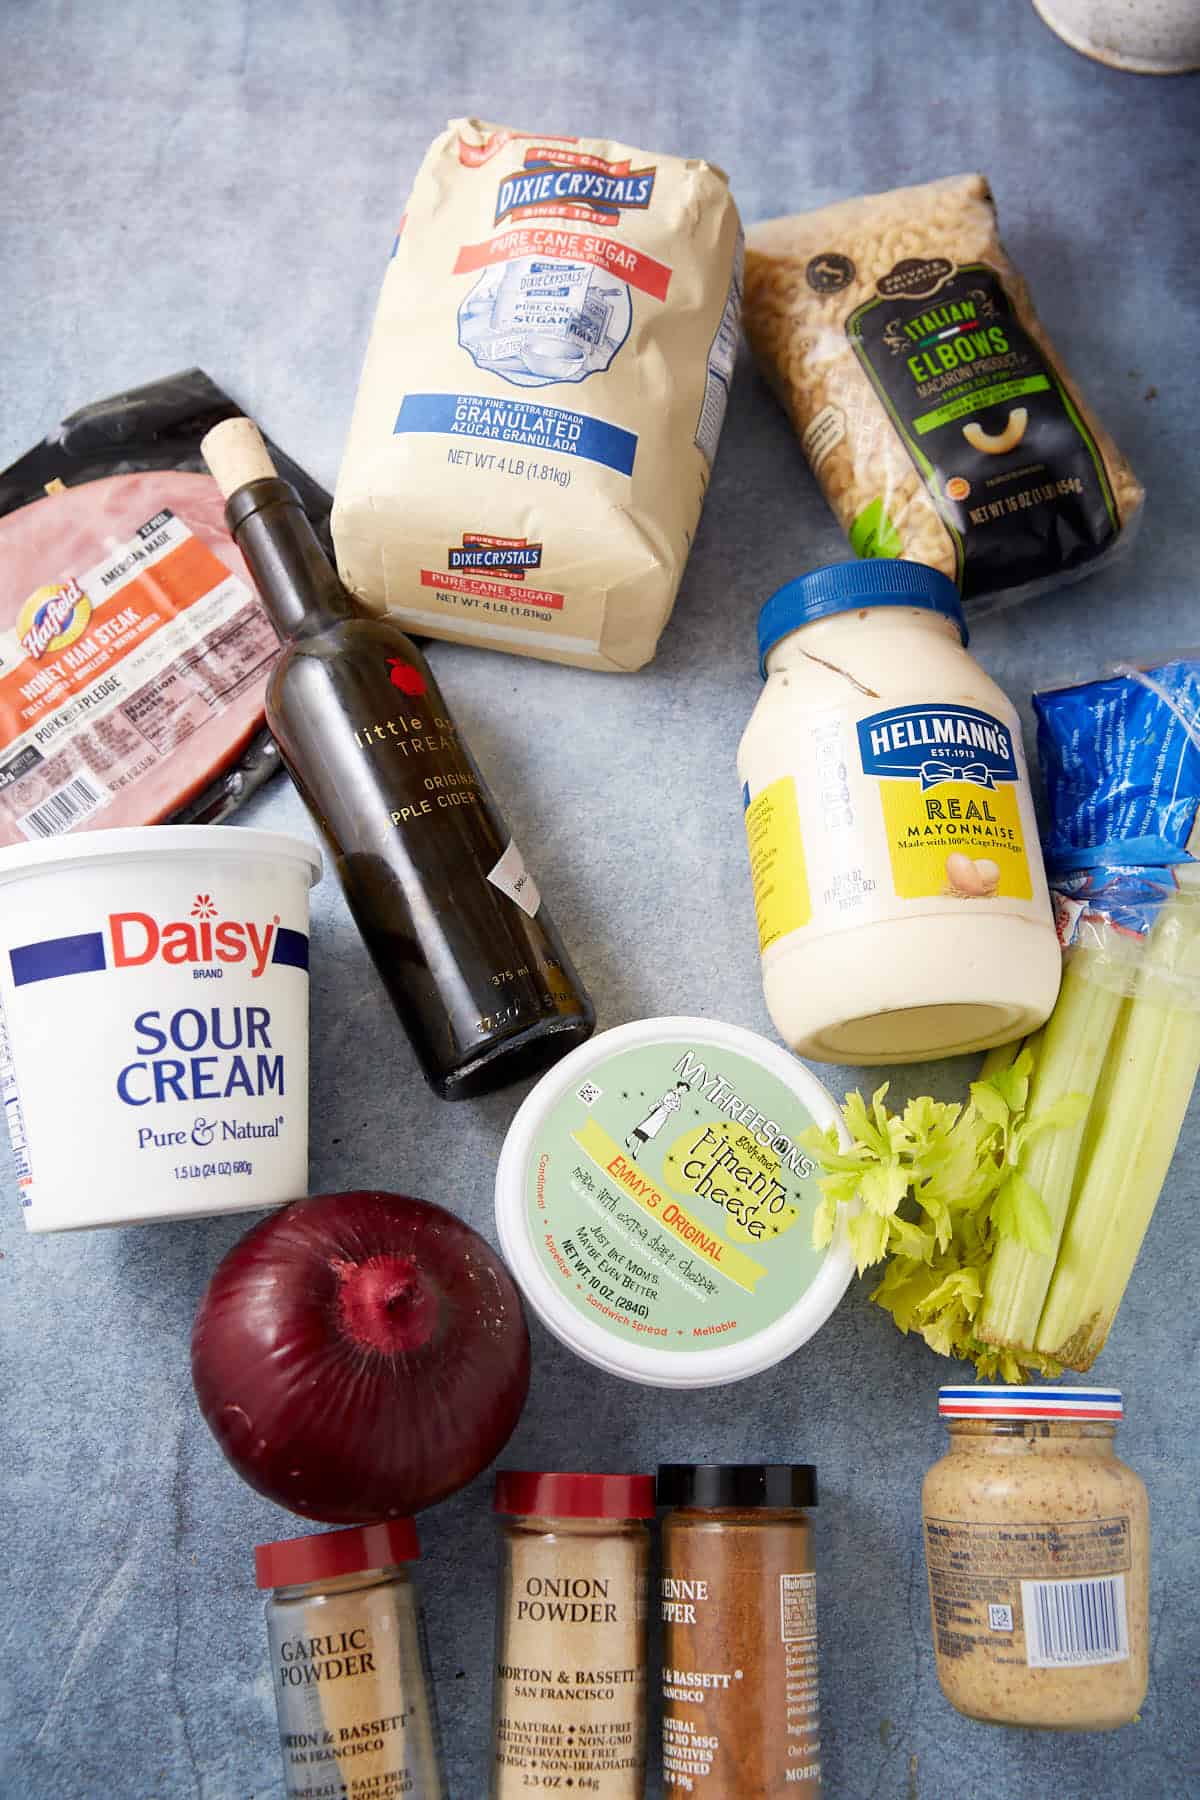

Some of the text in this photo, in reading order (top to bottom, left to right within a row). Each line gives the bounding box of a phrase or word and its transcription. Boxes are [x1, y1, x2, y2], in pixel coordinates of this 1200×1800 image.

[499, 172, 650, 215] DIXIE CRYSTALS
[490, 231, 529, 249] PURE
[533, 231, 579, 250] CANE
[584, 237, 639, 271] SUGAR
[903, 300, 977, 341] ITALIAN
[906, 326, 1009, 383] ELBOWS
[455, 404, 581, 441] GRANULATED
[456, 396, 584, 425] EXTRA FINE EXTRA REFINADA
[450, 421, 578, 454] AZÚCAR GRANULADA
[447, 448, 572, 489] NET WT 4 LB (1.81kg)
[144, 530, 173, 555] MADE
[452, 551, 540, 566] DIXIE CRYSTALS
[431, 573, 466, 587] PURE
[471, 581, 505, 593] CANE
[510, 587, 553, 603] SUGAR
[435, 591, 457, 604] NET
[460, 596, 480, 608] WT
[482, 601, 491, 611] 4
[493, 603, 509, 614] LB
[19, 661, 68, 702] HONEY
[63, 636, 101, 670] HAM
[94, 606, 143, 647] STEAK
[34, 673, 123, 745] PORK PLEDGE
[354, 715, 423, 749] little
[869, 717, 1011, 760] HELLMANN'S
[925, 798, 997, 822] REAL
[907, 823, 1015, 840] MAYONNAISE
[926, 837, 947, 846] with
[108, 898, 275, 978] Daisy
[192, 967, 224, 979] BRAND
[491, 969, 514, 985] 375
[133, 1006, 274, 1056] SOUR
[116, 1054, 286, 1107] CREAM
[137, 1126, 188, 1149] Pure
[191, 1116, 219, 1147] &
[173, 1166, 189, 1180] 1.5
[202, 1163, 217, 1180] (24
[606, 1155, 723, 1263] EMMY'S ORIGINAL
[575, 1225, 660, 1301] MAYBE EVEN BETTER
[560, 1238, 579, 1260] NET
[588, 1275, 600, 1290] 10
[614, 1295, 650, 1320] (284G)
[585, 1293, 669, 1337] Sandwich Spread
[525, 1576, 610, 1600] ONION
[662, 1578, 708, 1601] ENNE
[516, 1601, 618, 1624] POWDER
[280, 1628, 368, 1663] GARLIC
[280, 1651, 377, 1687] POWDER
[557, 1670, 571, 1684] &
[575, 1669, 636, 1685] BASSETT
[673, 1670, 732, 1689] BASSETT
[514, 1686, 615, 1701] SAN FRANCISCO
[339, 1714, 409, 1742] BASSETT
[514, 1719, 565, 1735] NATURAL
[579, 1722, 608, 1734] SALT
[535, 1735, 562, 1747] FREE
[577, 1734, 632, 1747] NON-GMO
[310, 1738, 385, 1762] FRANCISCO
[507, 1744, 589, 1759] PRESERVATIVE
[690, 1735, 720, 1750] MSG
[351, 1775, 381, 1791] SALT
[542, 1776, 562, 1788] OZ
